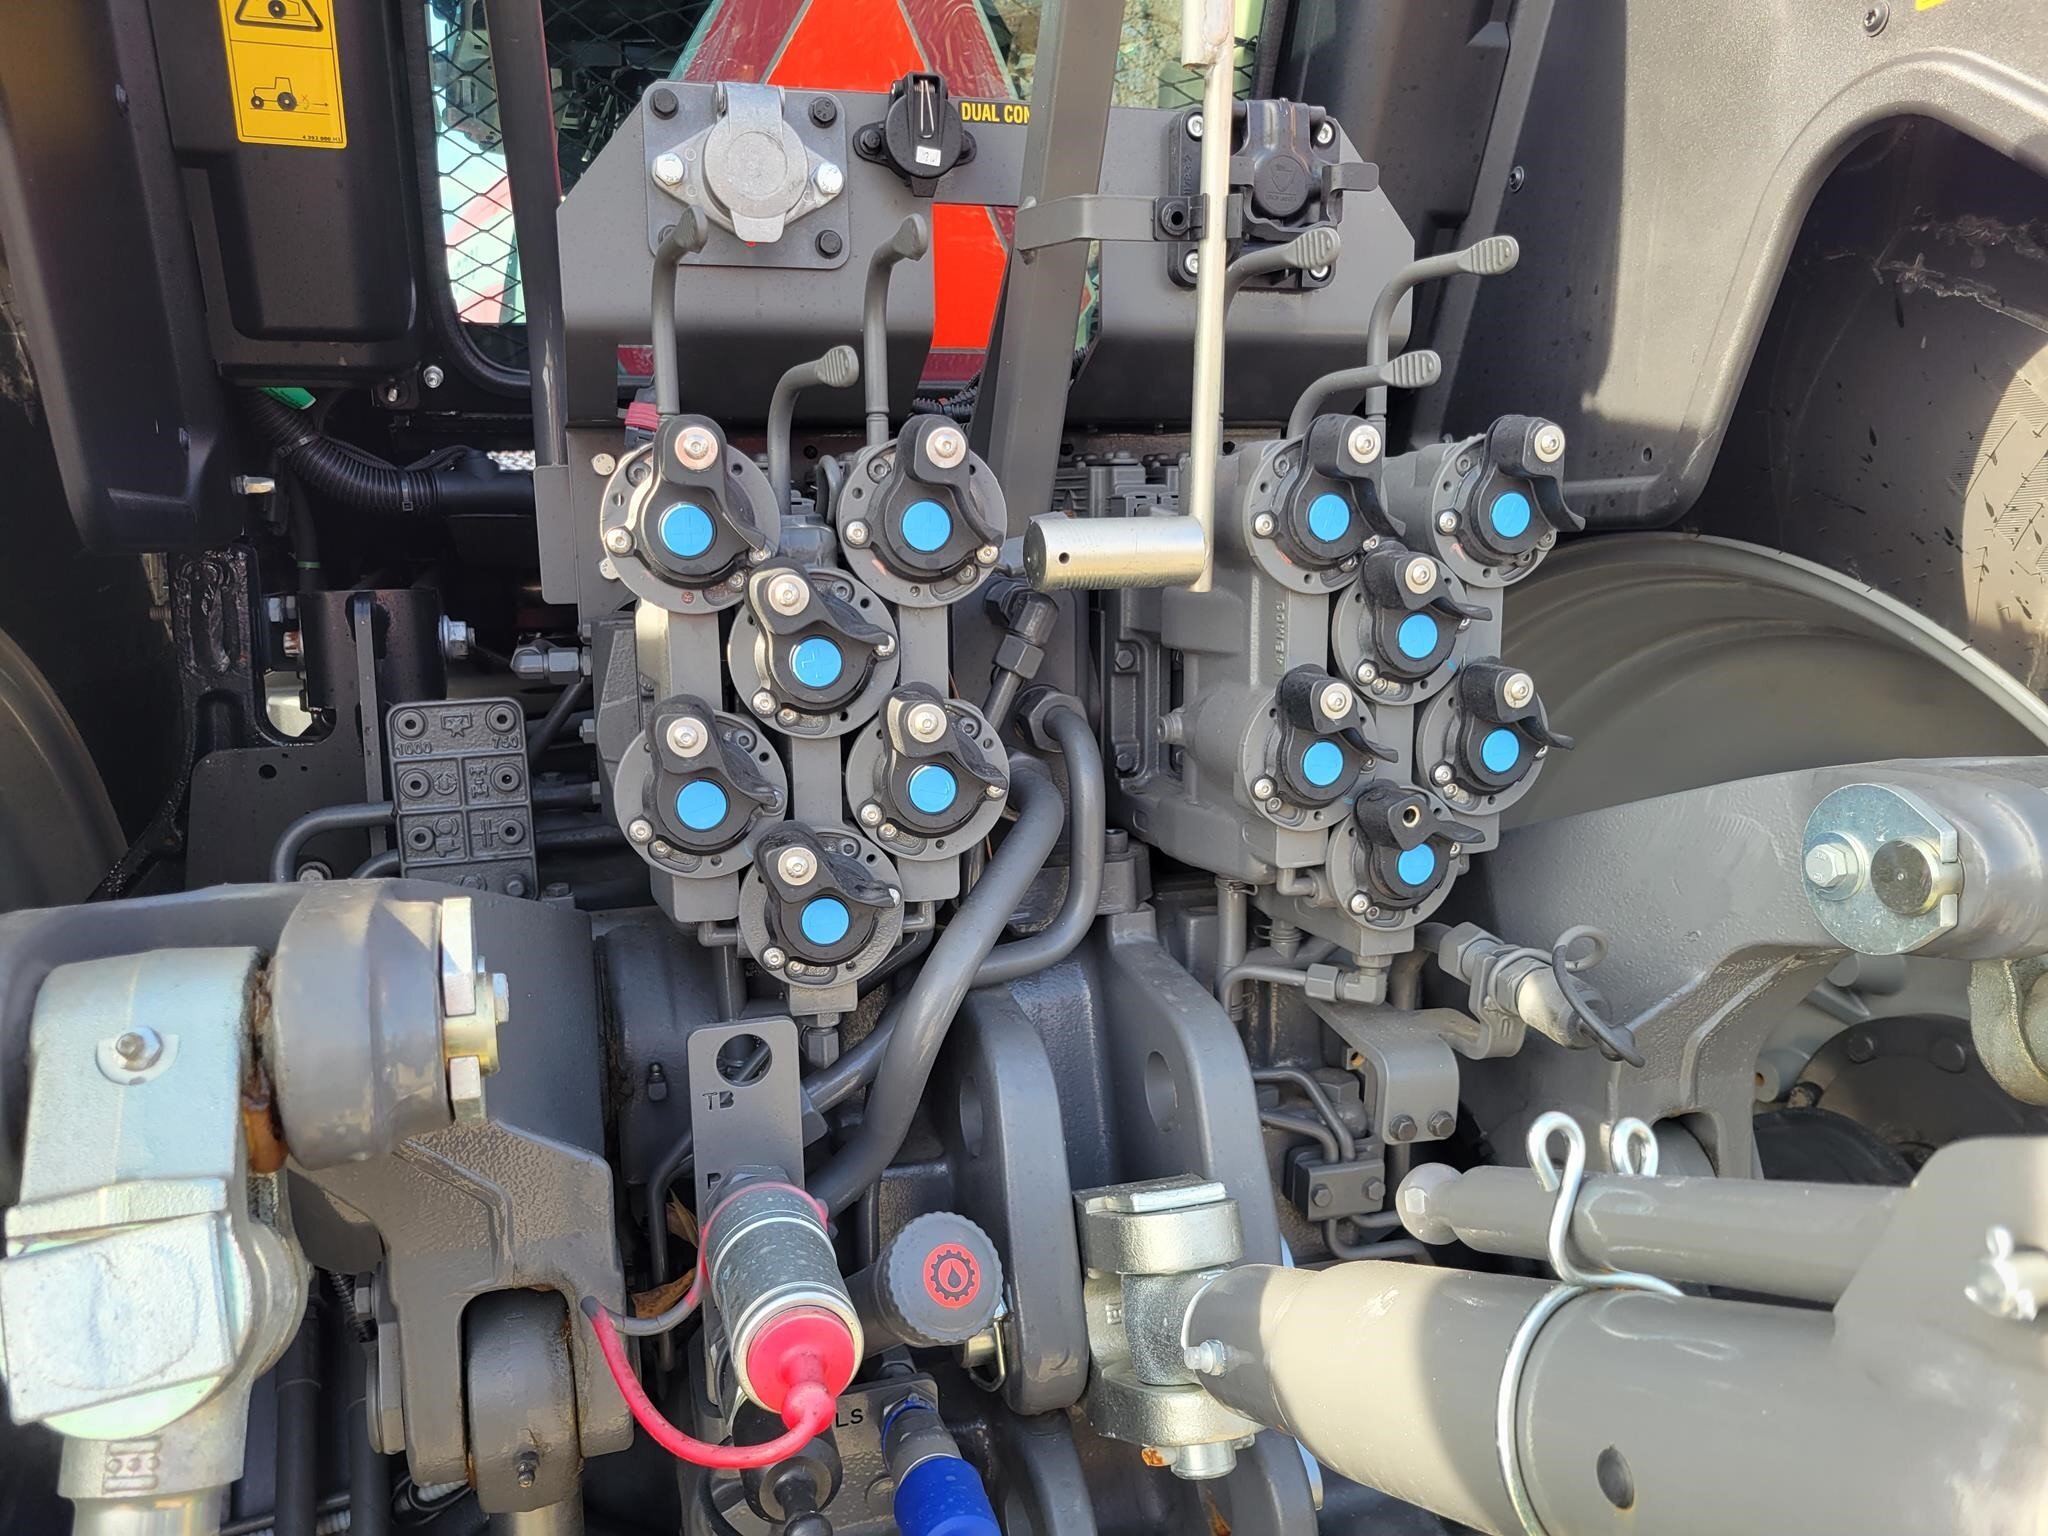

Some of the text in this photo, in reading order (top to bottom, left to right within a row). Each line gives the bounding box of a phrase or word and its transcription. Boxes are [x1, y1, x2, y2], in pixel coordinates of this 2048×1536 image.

[961, 102, 1000, 122] DUAL
[395, 742, 432, 755] 1000
[492, 736, 519, 749] 750
[702, 1090, 735, 1111] TB
[835, 1409, 863, 1428] LS
